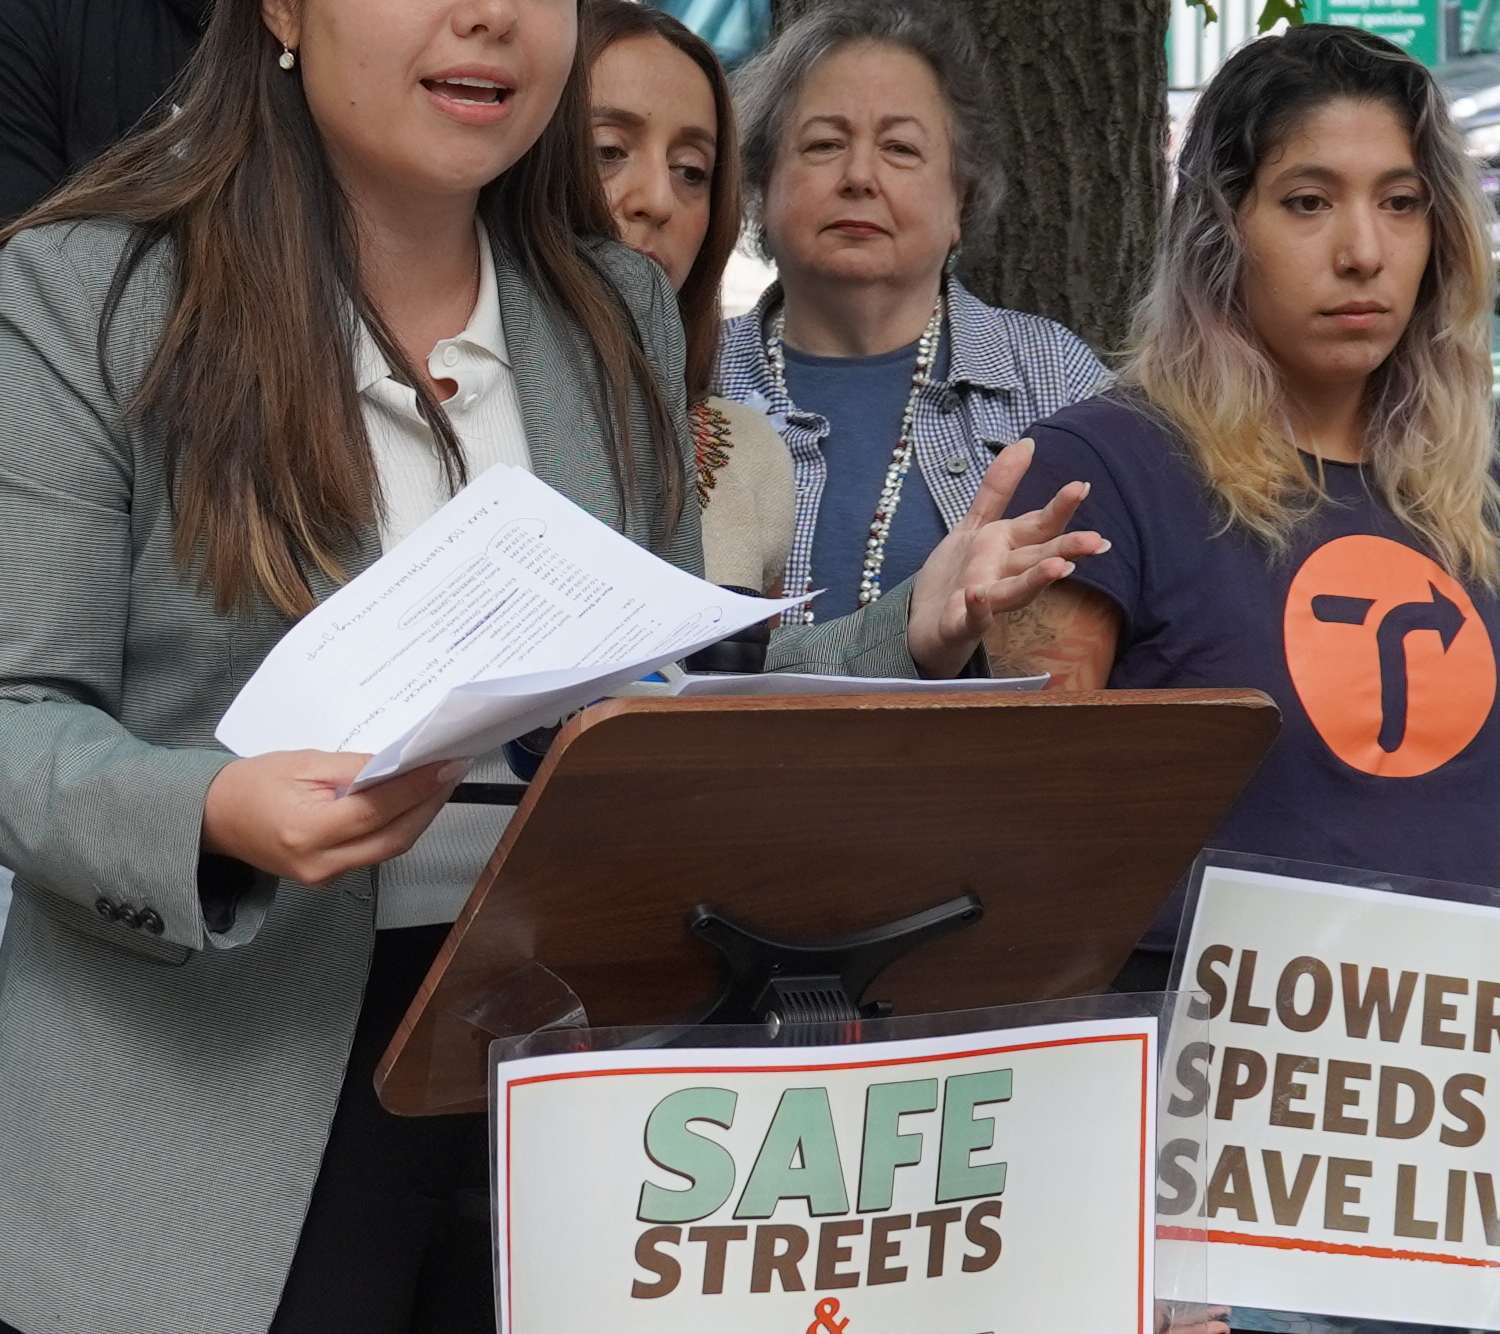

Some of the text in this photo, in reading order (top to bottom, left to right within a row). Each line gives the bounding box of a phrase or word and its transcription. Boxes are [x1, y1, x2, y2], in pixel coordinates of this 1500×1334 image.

[636, 1068, 1013, 1225] SAFE
[1166, 1042, 1488, 1149] SPEEDS
[1156, 1137, 1372, 1235] SAVE
[630, 1200, 1004, 1301] STREETS
